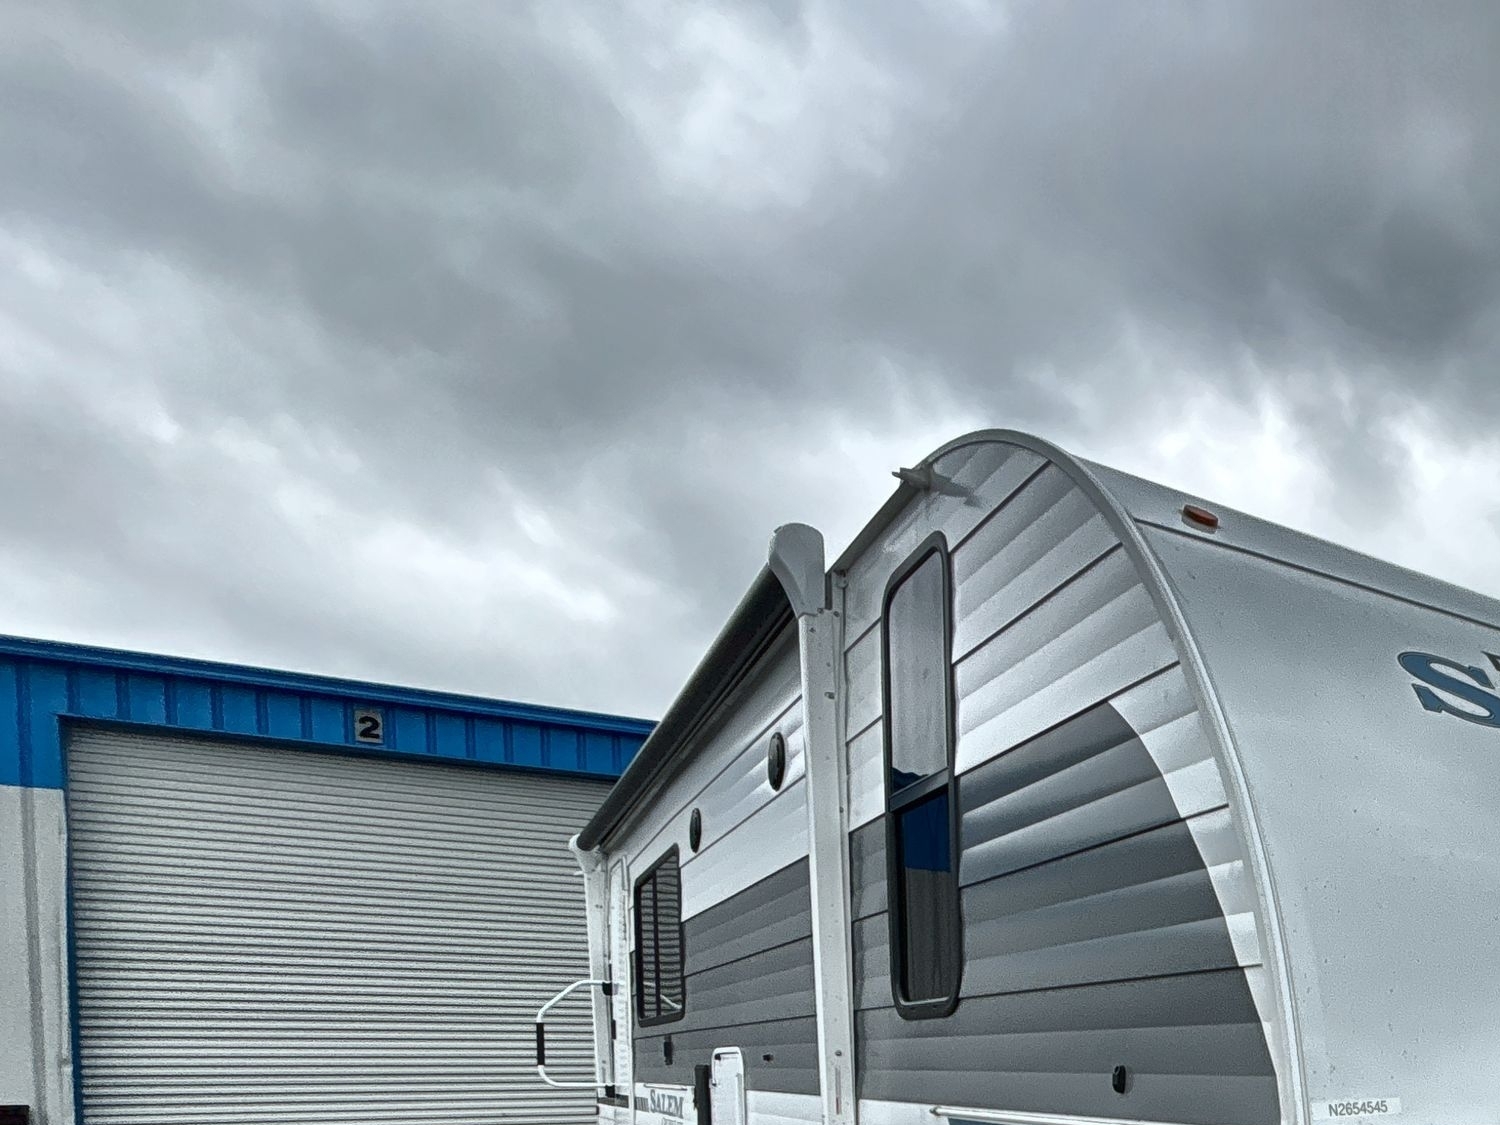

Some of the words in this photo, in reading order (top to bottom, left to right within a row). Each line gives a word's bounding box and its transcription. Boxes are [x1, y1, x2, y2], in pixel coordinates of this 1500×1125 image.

[358, 716, 380, 739] 2
[650, 1089, 684, 1119] SALEM
[1328, 1100, 1388, 1117] N2654545
